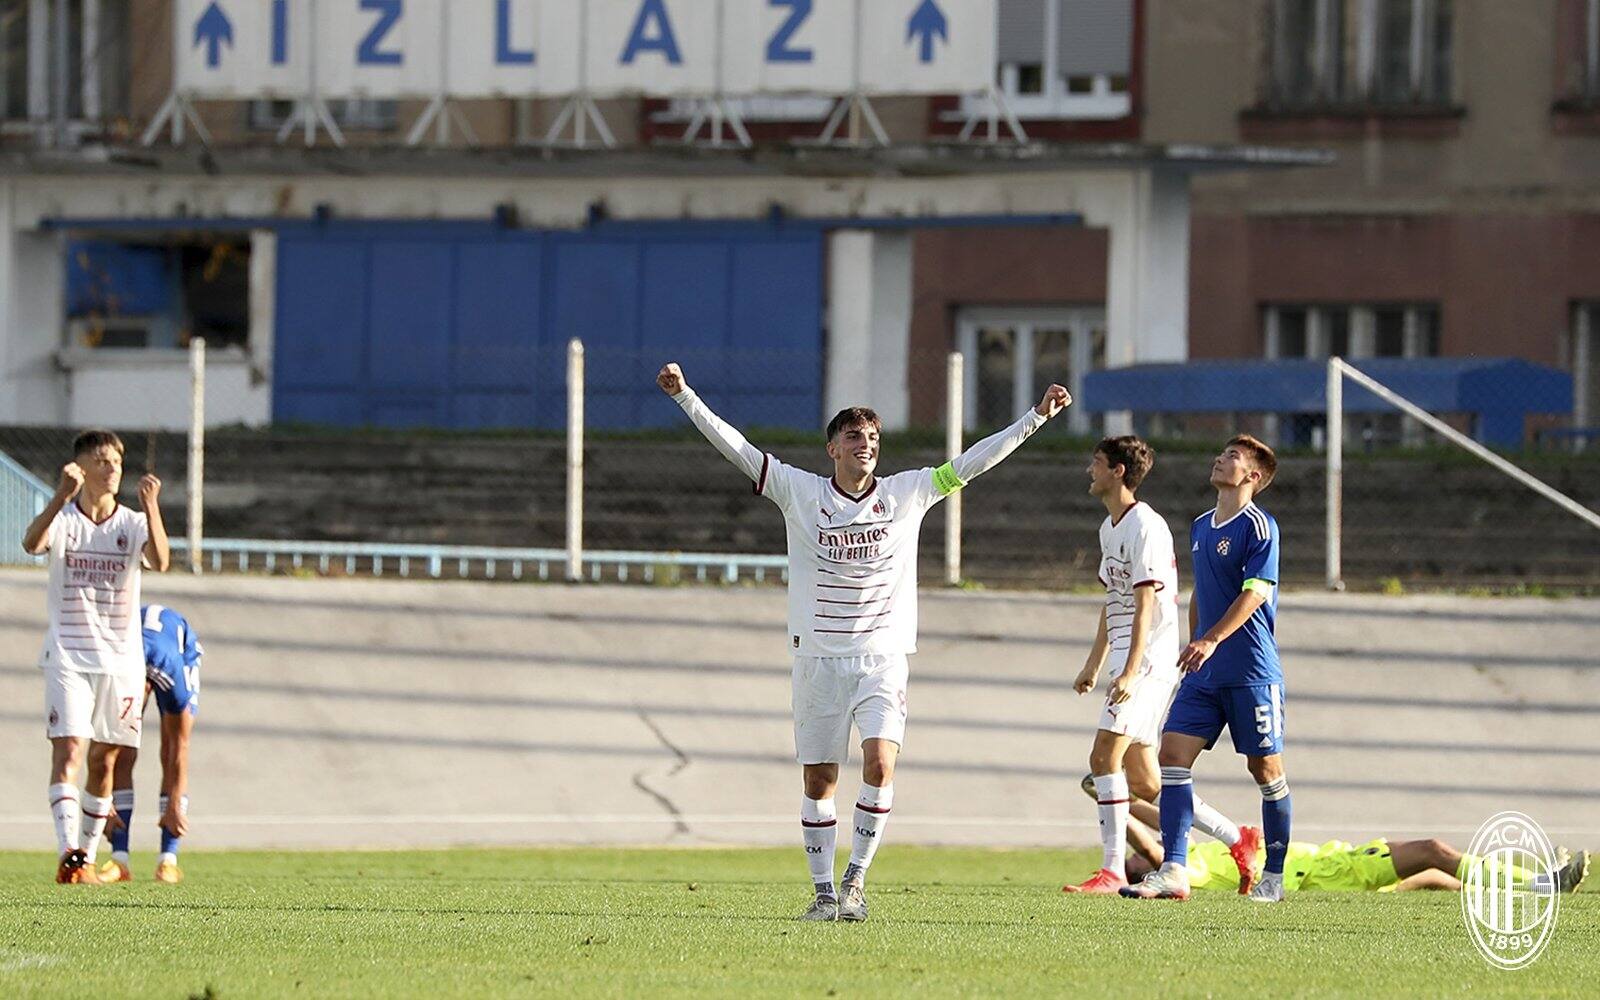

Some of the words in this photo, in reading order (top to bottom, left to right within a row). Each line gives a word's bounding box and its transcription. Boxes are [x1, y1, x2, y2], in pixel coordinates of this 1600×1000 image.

[271, 0, 815, 66] IZLAZ
[828, 547, 844, 560] FLY
[846, 544, 880, 560] BETTER
[1254, 704, 1272, 734] 5
[856, 826, 876, 838] ACM
